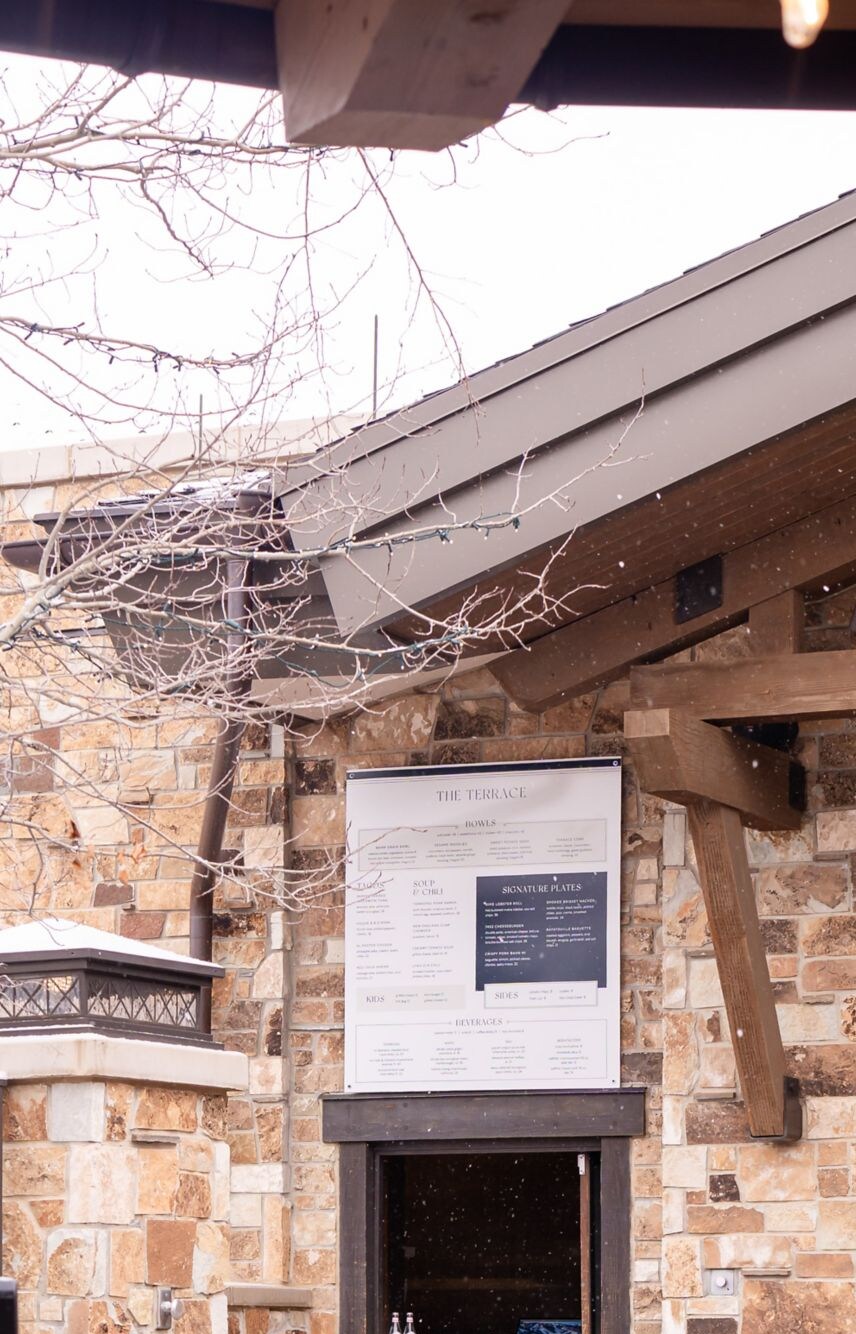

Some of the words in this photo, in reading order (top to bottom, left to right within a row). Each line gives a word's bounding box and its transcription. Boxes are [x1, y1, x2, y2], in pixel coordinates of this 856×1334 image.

[437, 791, 461, 802] THE
[467, 786, 527, 801] TERRACE
[465, 819, 497, 828] BOWLS
[412, 880, 436, 888] SOUP
[501, 885, 549, 894] SIGNATURE
[551, 883, 582, 892] PLATES
[422, 888, 443, 896] CHILI
[366, 995, 385, 1003] KIDS
[494, 991, 519, 1000] SIDES
[455, 1018, 503, 1027] BEVERAGES
